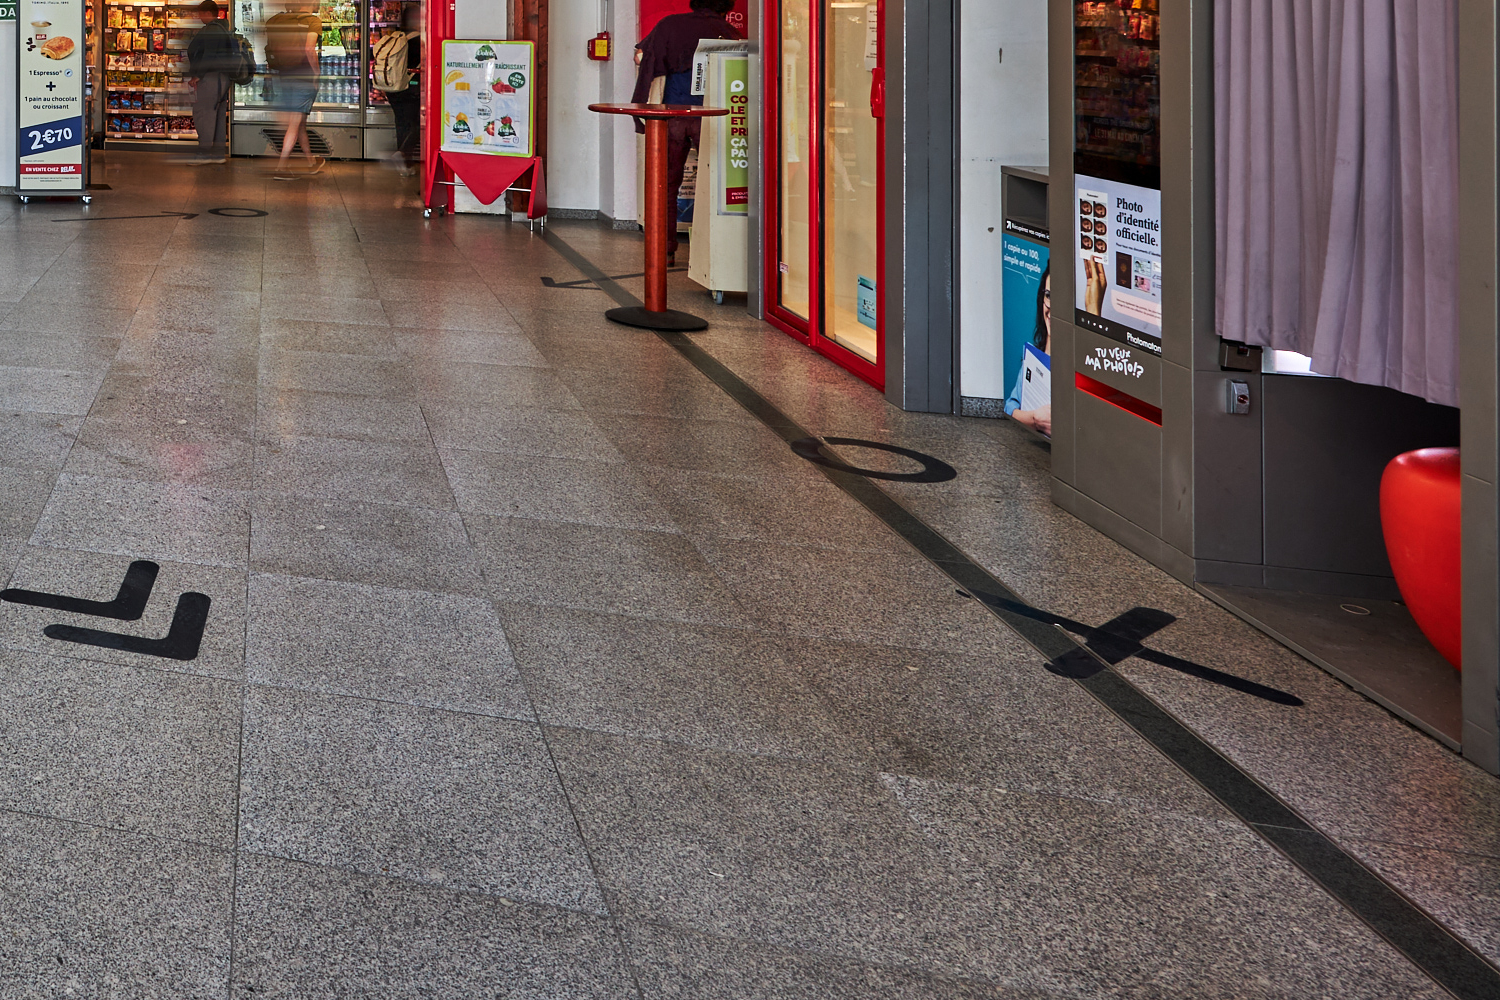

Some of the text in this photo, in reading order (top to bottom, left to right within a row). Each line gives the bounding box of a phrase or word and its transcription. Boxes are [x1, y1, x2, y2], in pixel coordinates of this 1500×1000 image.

[0, 8, 16, 17] DA
[510, 76, 524, 85] VENTE
[731, 106, 745, 114] LE
[731, 117, 746, 125] ET
[28, 127, 73, 150] 2€70
[731, 138, 747, 148] ÇA
[1116, 197, 1143, 213] Photo
[1116, 211, 1159, 232] d'identité
[1116, 227, 1159, 246] officielle.
[1008, 244, 1020, 253] copie
[1004, 253, 1018, 265] simple
[1025, 263, 1041, 273] rapide
[1095, 347, 1131, 360] TU VEUX
[1085, 355, 1144, 378] MA PHOTO!?
